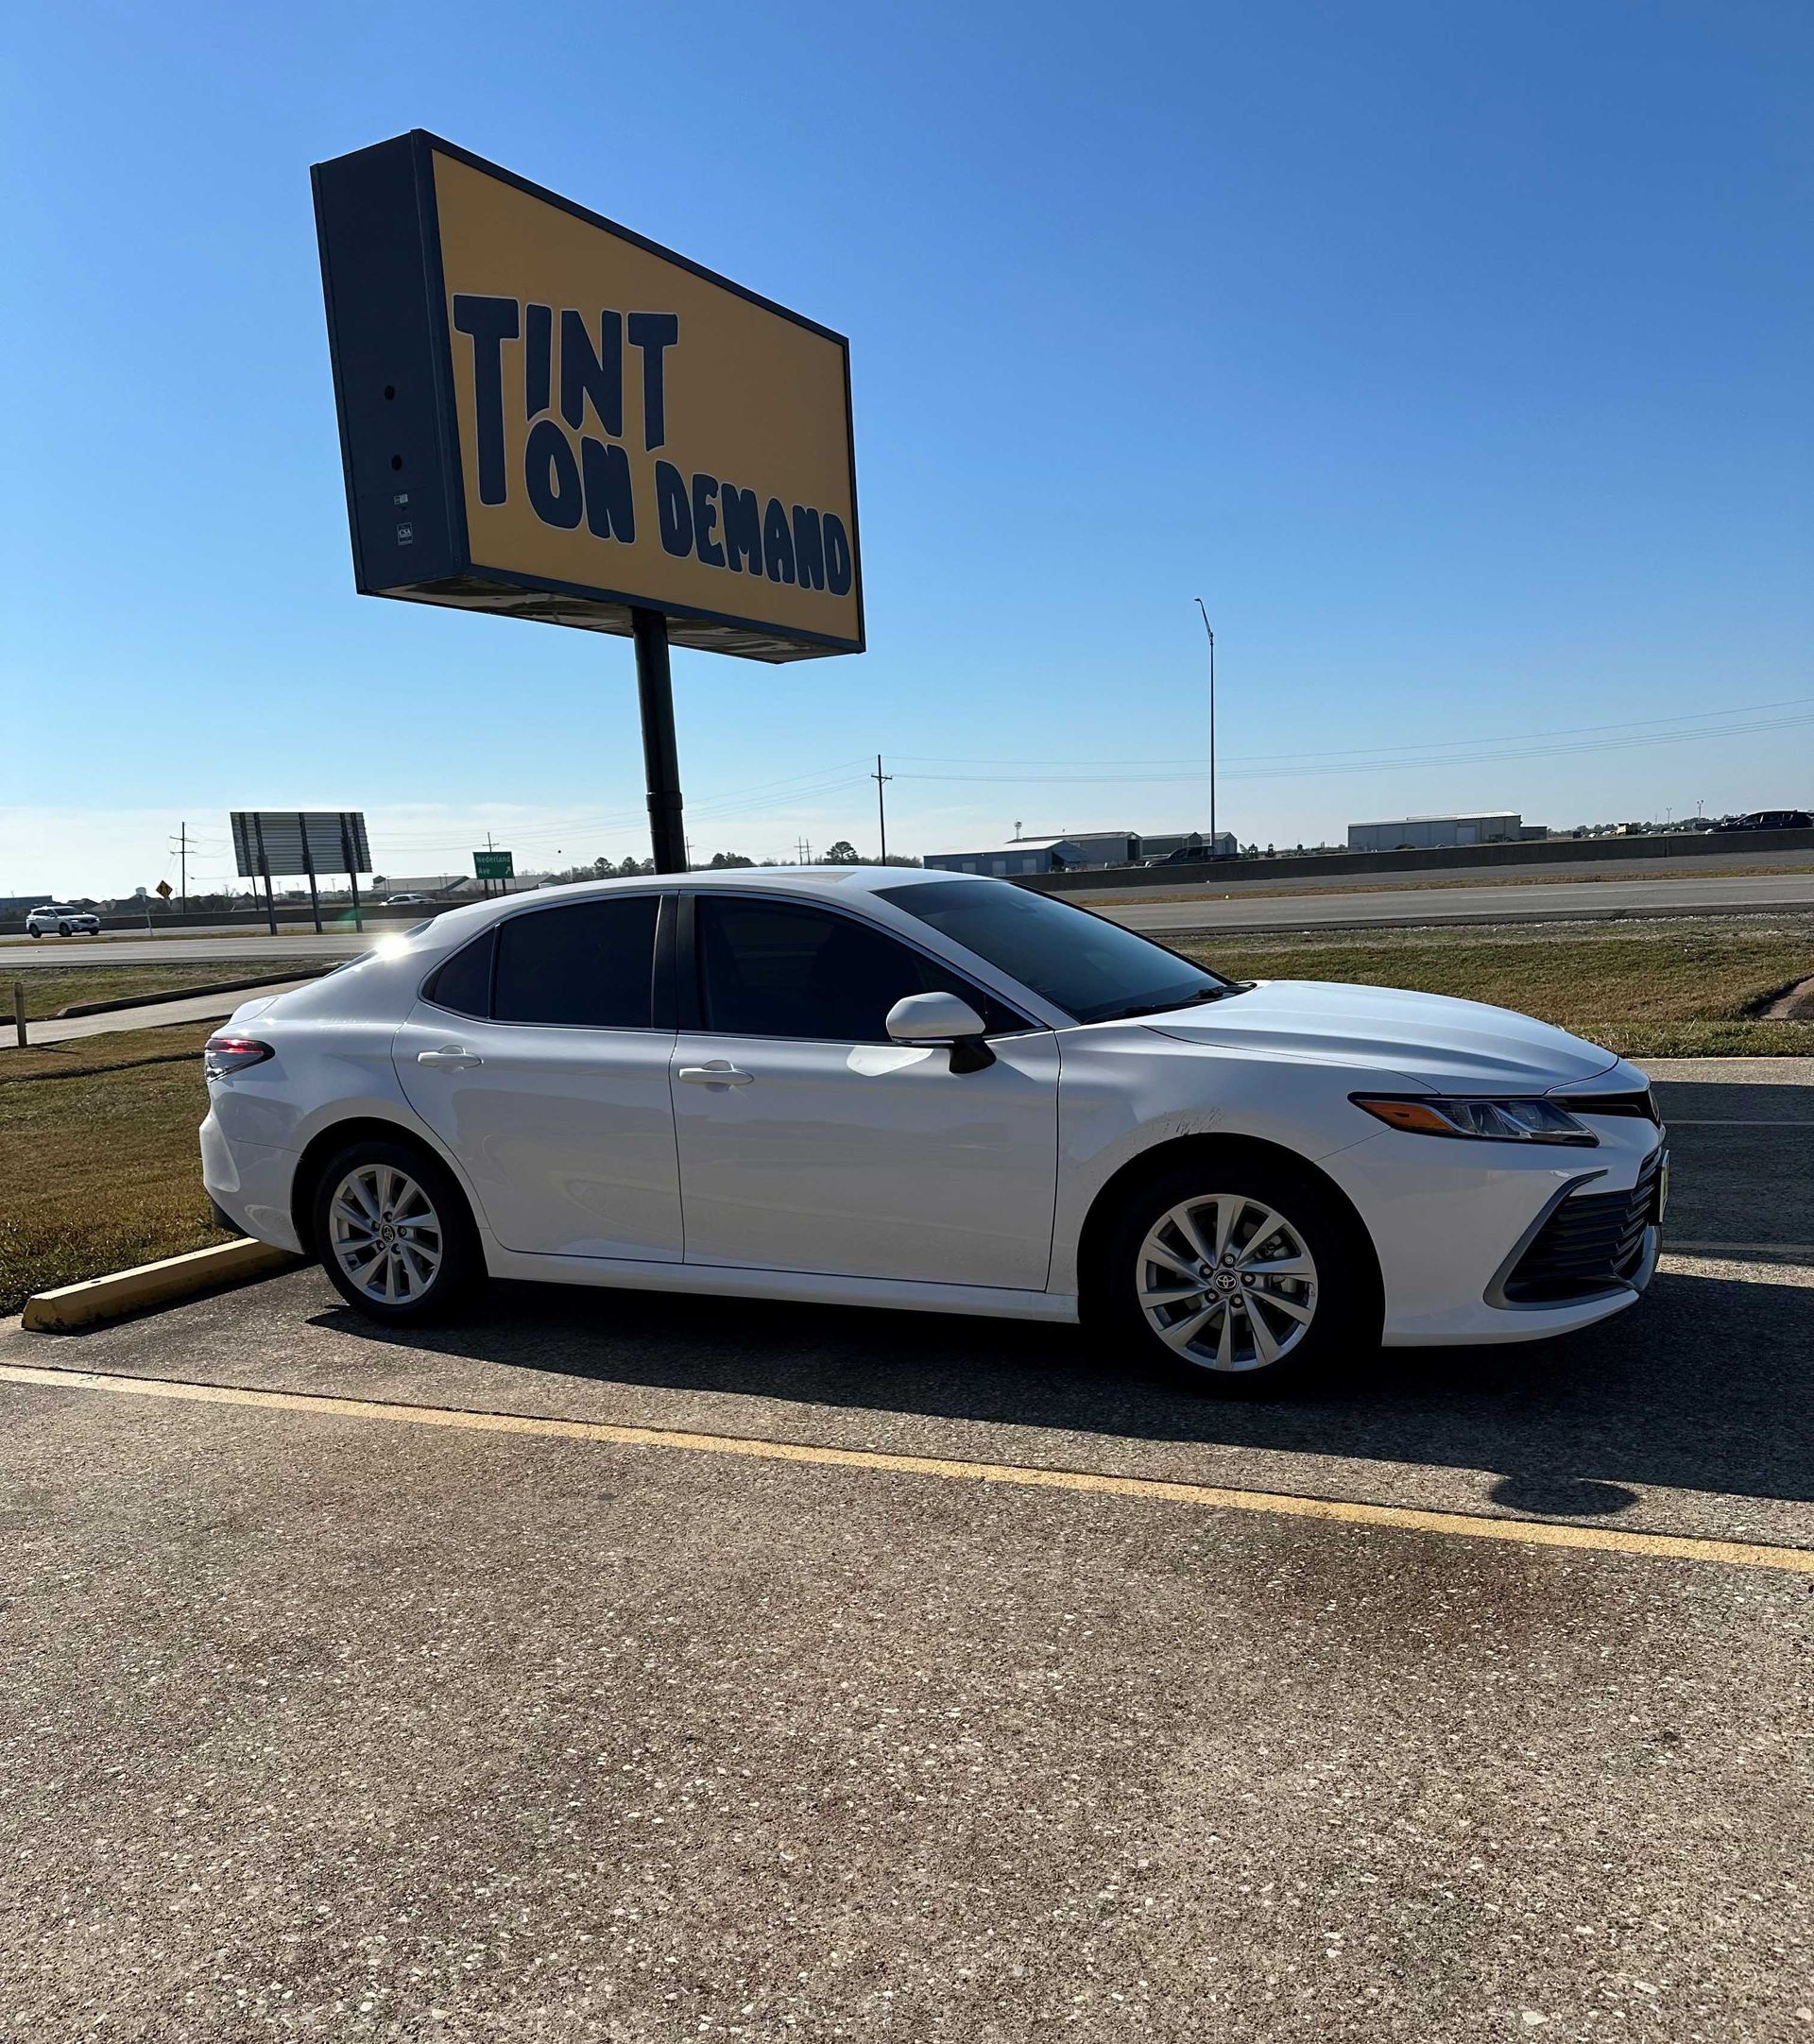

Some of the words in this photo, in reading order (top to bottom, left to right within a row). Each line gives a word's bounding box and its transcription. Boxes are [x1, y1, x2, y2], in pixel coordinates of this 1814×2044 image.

[454, 294, 678, 506] TINT
[525, 419, 635, 544] ON
[655, 460, 852, 597] DEMAND
